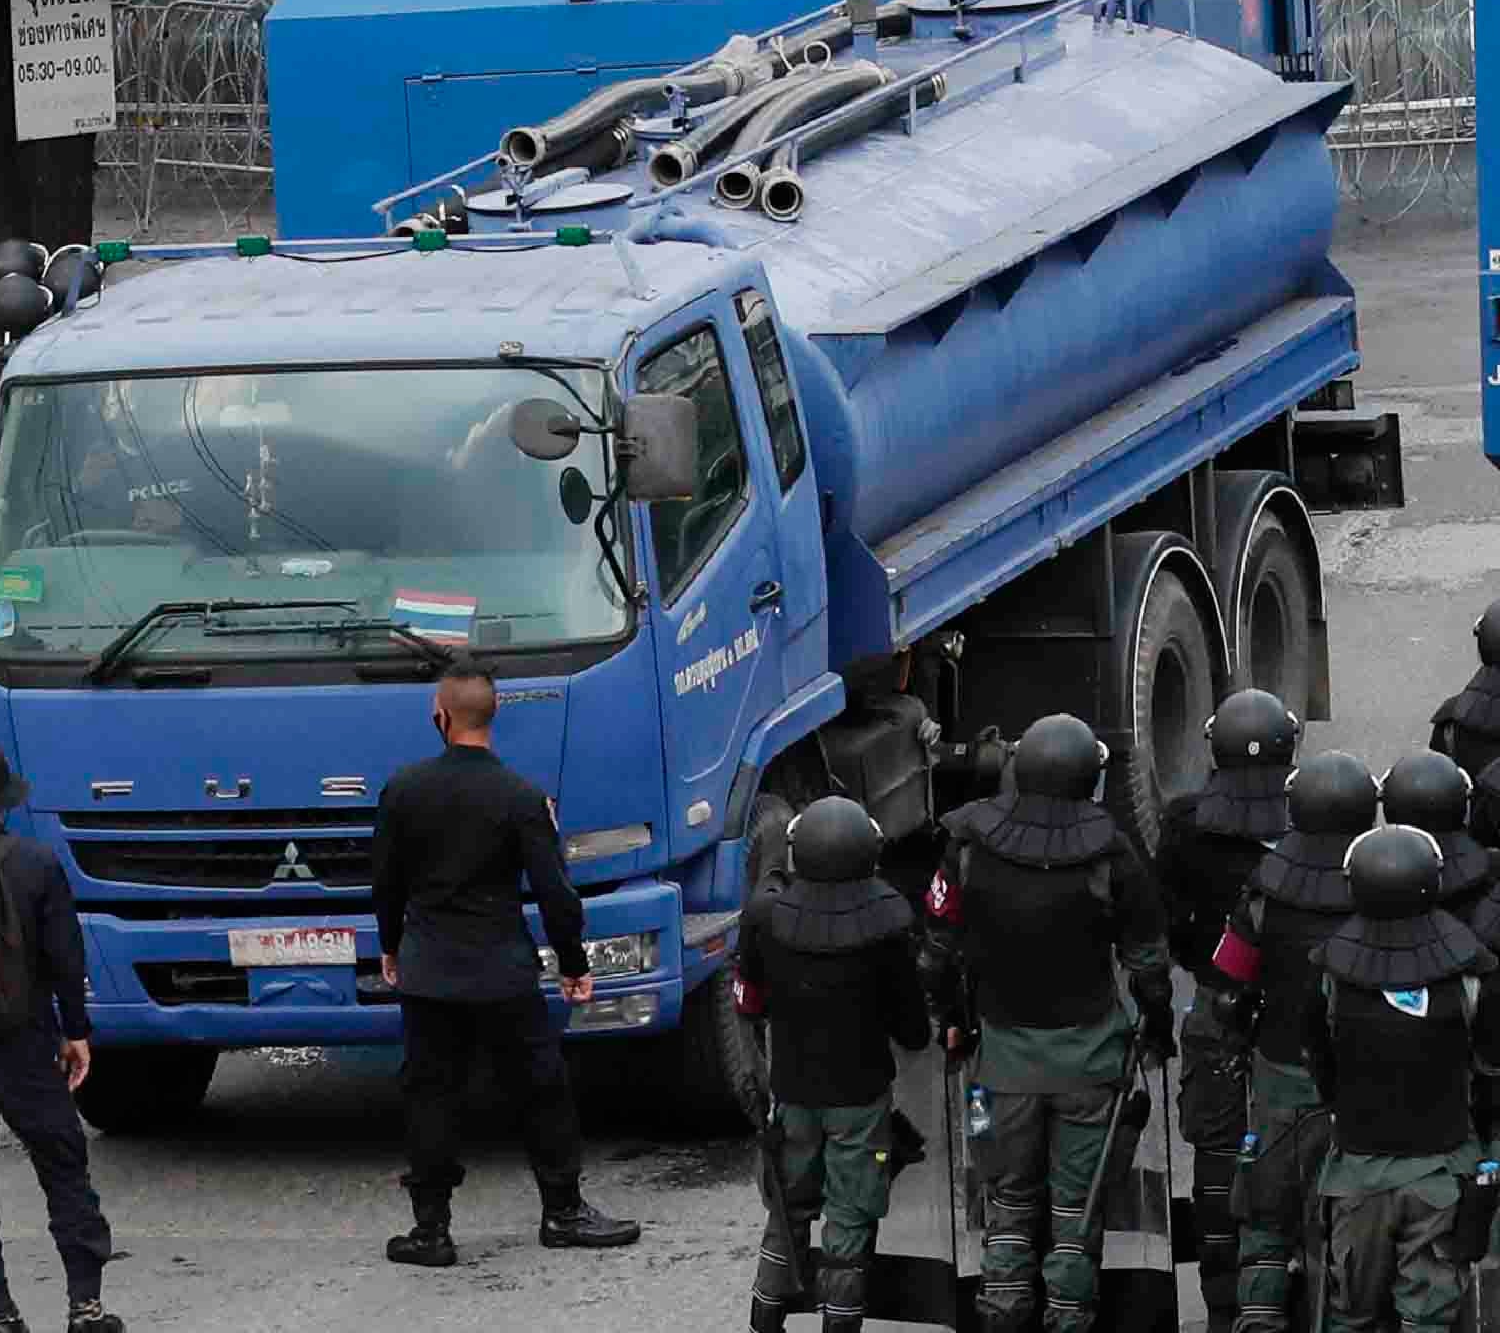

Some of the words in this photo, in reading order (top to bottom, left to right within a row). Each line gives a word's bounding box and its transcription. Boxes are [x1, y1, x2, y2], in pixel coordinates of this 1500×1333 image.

[18, 12, 106, 46] ช่องทางพิเศษ
[18, 55, 100, 83] 05.30-09.00
